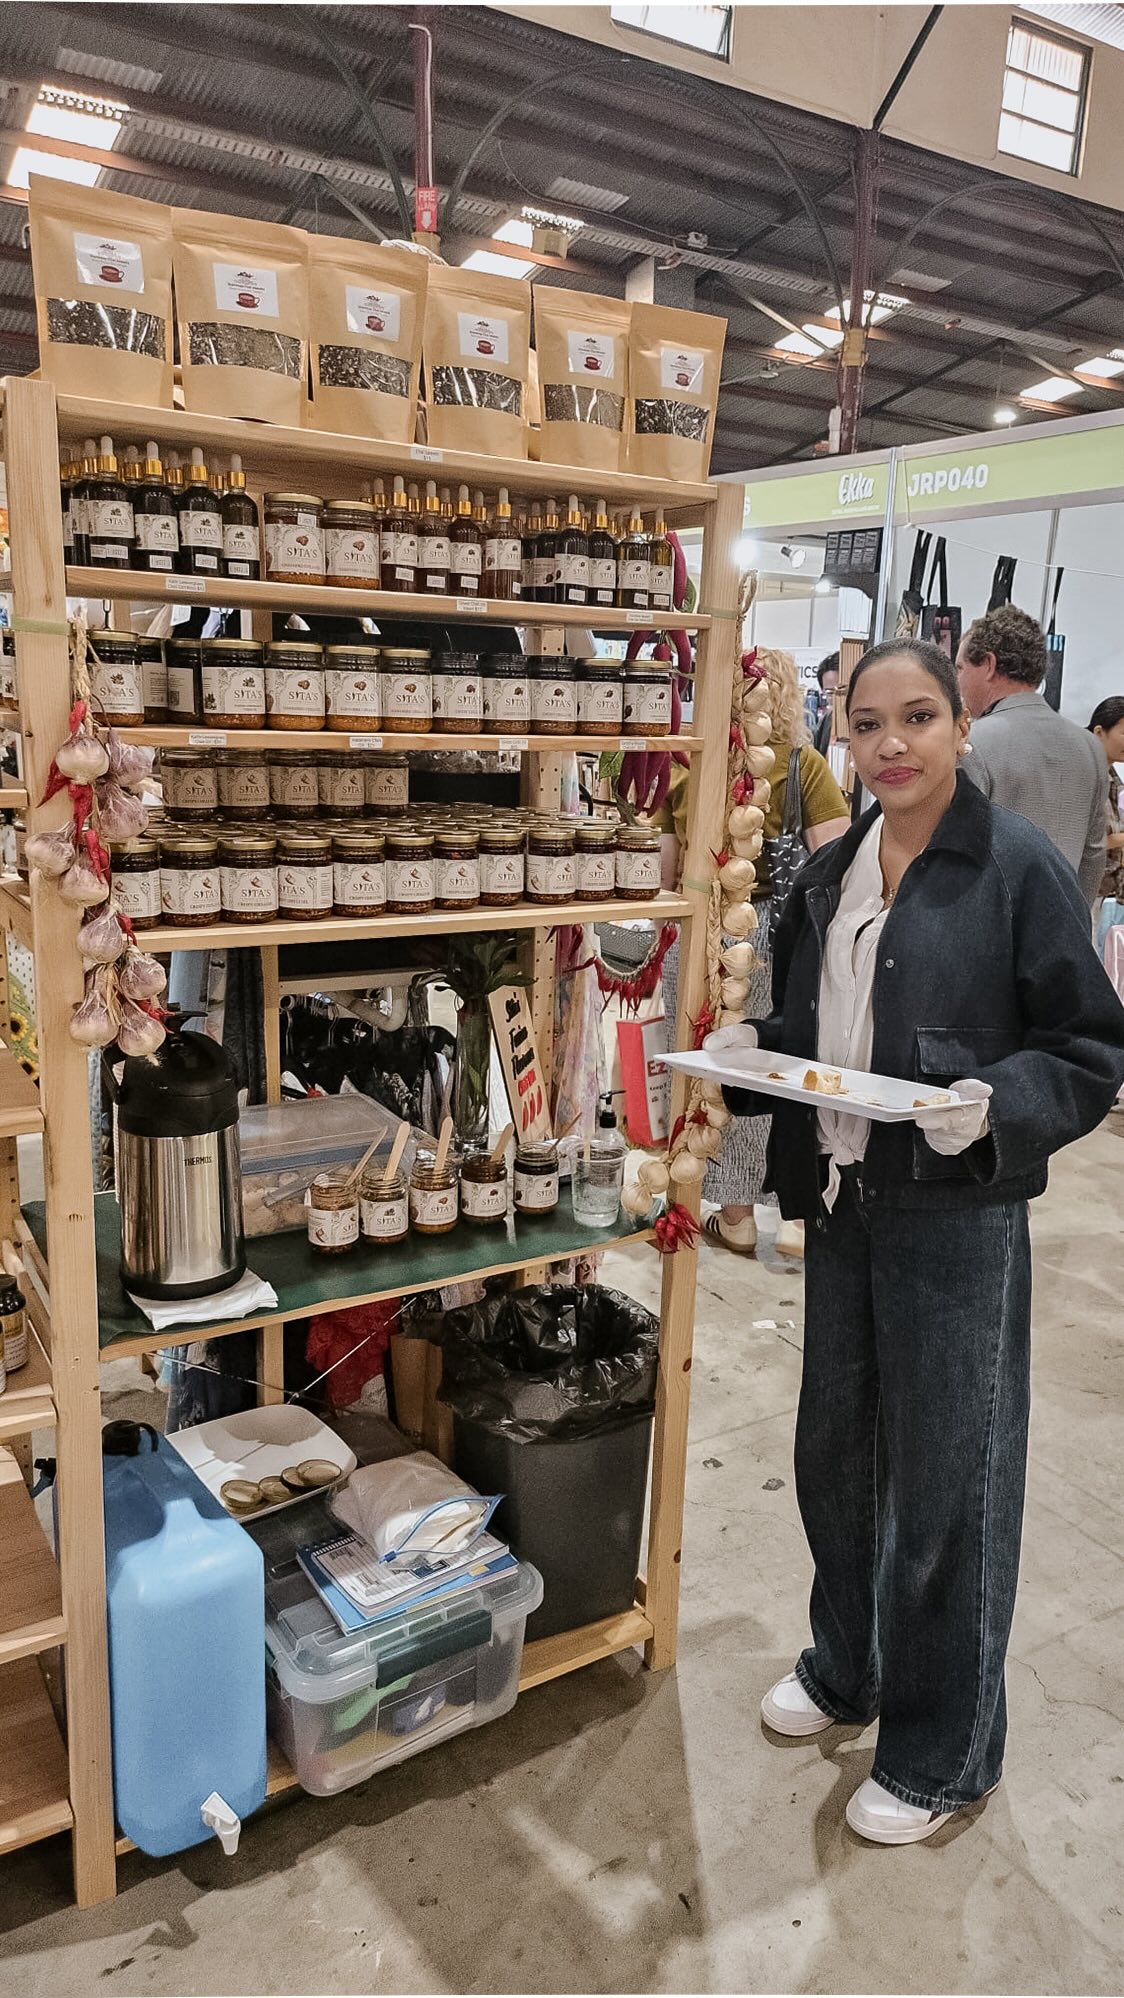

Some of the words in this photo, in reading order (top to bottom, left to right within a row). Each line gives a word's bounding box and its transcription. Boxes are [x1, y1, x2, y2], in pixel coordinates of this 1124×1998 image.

[908, 464, 989, 497] JRP040
[839, 473, 875, 506] Ekka
[287, 547, 318, 559] SITA'S
[344, 552, 374, 564] SITA'S
[234, 690, 263, 699] SITA'S
[289, 691, 319, 701] SITA'S
[345, 692, 376, 702] SITA'S
[396, 695, 426, 704] SITA'S
[545, 699, 573, 708] SITA'S
[186, 787, 213, 796] SITA'S
[239, 785, 266, 794] SITA'S
[402, 880, 430, 889] SITA'S
[449, 878, 476, 887] SITA'S
[353, 883, 381, 892] SITA'S
[241, 888, 272, 898] SITA'S
[184, 1156, 213, 1167] THERMOS
